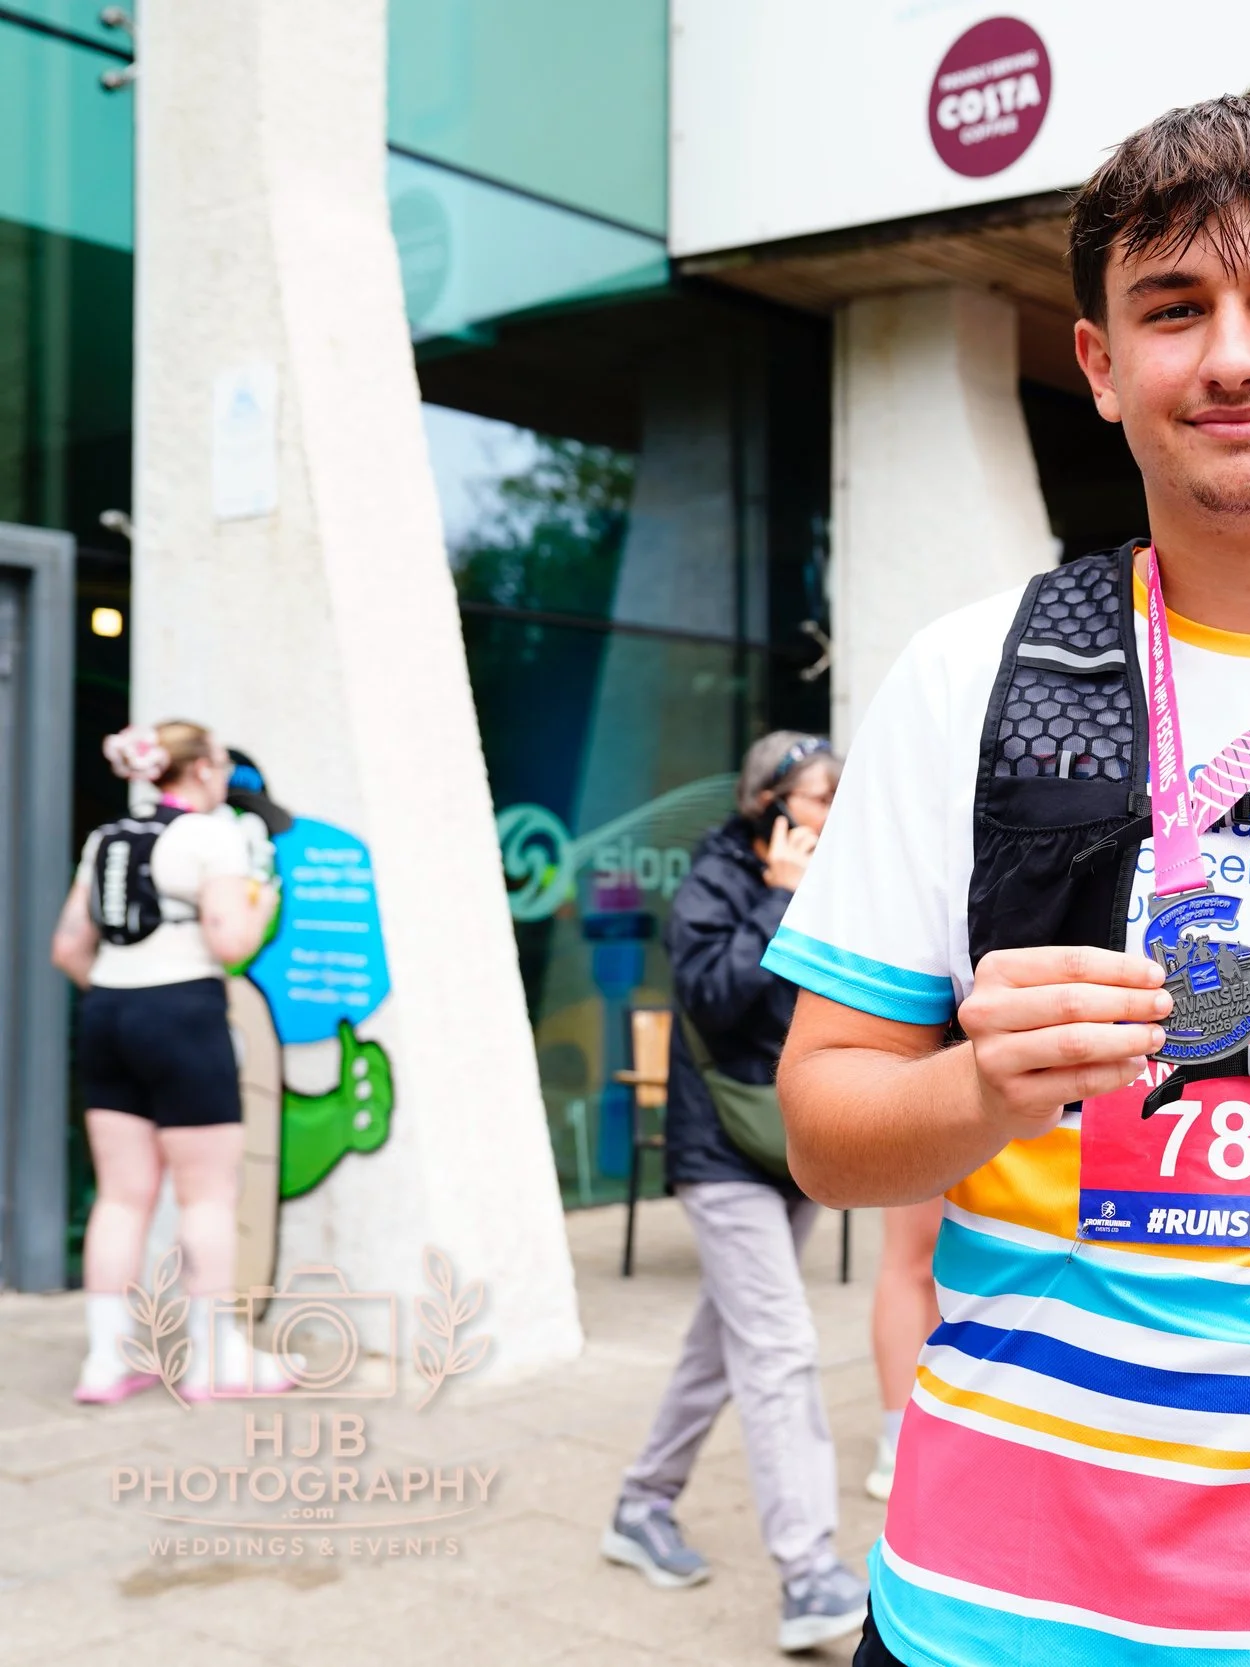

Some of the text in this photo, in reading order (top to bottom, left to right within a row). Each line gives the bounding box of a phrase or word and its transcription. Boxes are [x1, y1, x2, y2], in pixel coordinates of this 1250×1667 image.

[937, 72, 1041, 131] COSTA
[1152, 620, 1165, 685] Marathon
[1153, 683, 1168, 715] Half
[1156, 709, 1178, 793] SWANSEA
[1202, 1019, 1232, 1036] 2026
[1084, 1218, 1131, 1227] FRONTRUNNER
